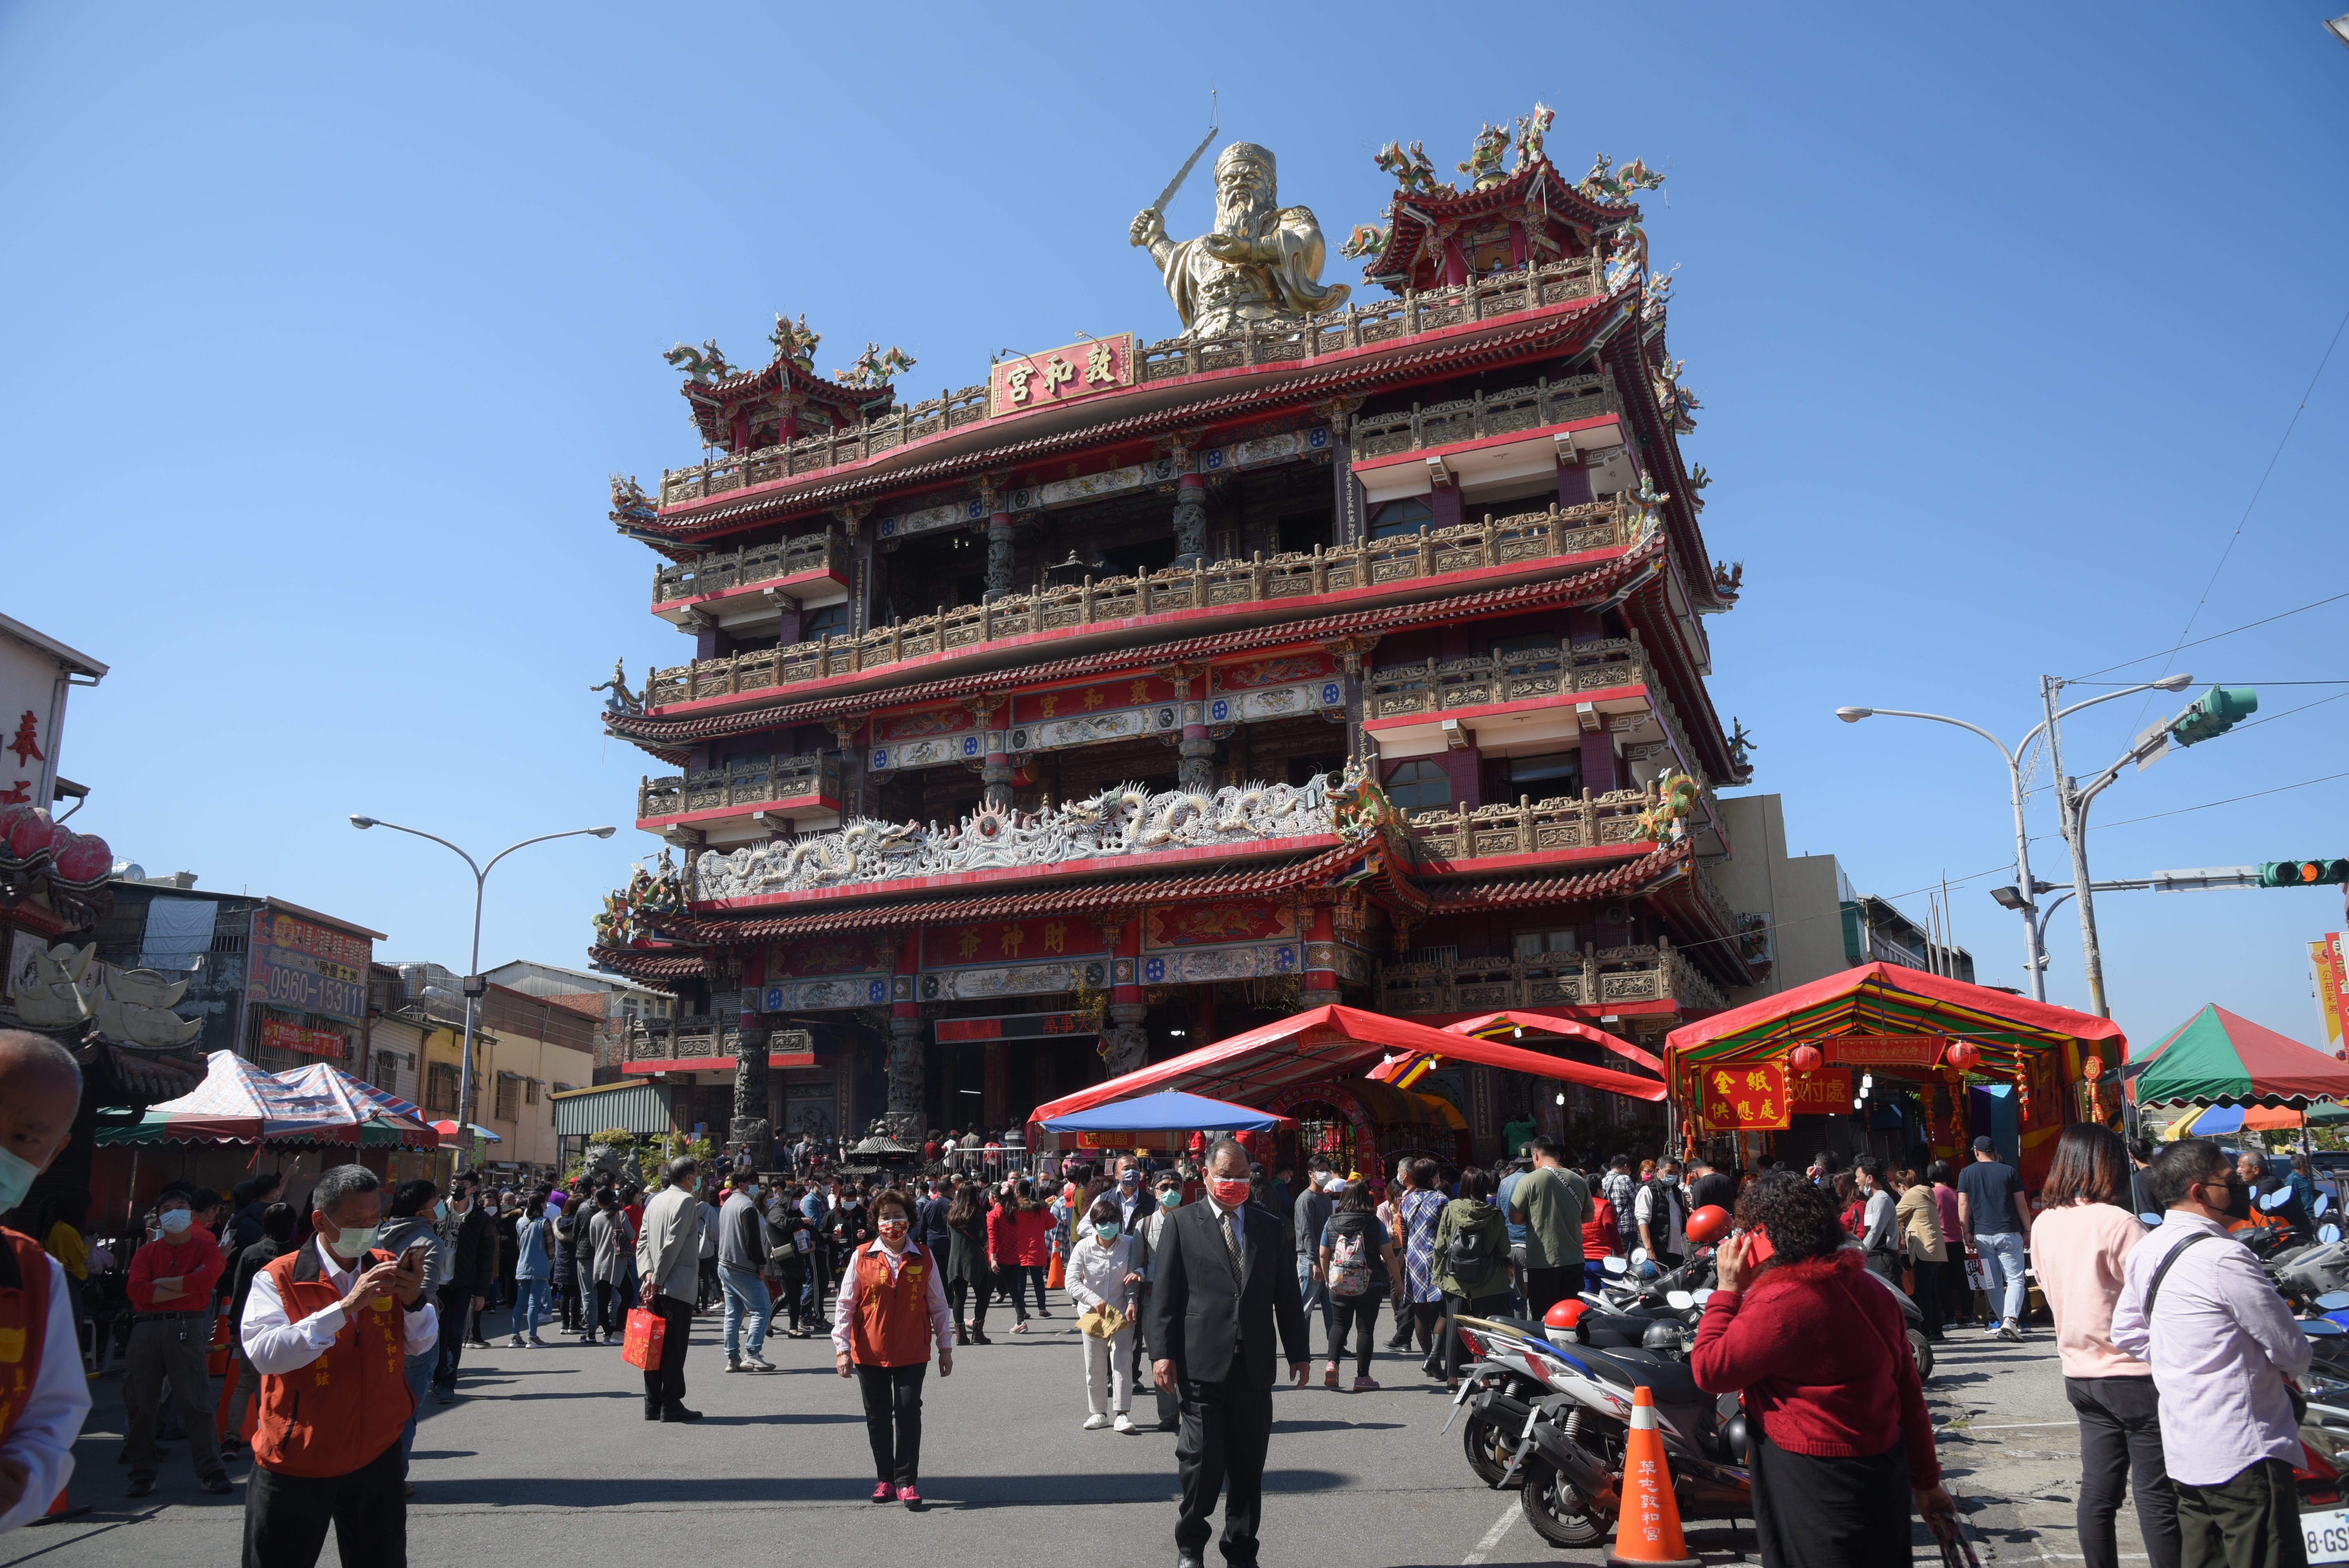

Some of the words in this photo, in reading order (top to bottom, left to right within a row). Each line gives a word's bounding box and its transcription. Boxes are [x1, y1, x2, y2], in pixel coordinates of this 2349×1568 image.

[1007, 343, 1116, 403] 敦和宮
[1040, 680, 1152, 718] 敦和宮
[957, 919, 1068, 961] 財神爺
[319, 960, 358, 983] 房屋土地
[271, 966, 365, 1017] 0960-153111
[2322, 970, 2339, 1015] 公益彩券
[273, 1024, 280, 1039] 賀
[2085, 1059, 2096, 1074] 福
[1713, 1071, 1772, 1095] 金紙
[1711, 1099, 1779, 1121] 供應處
[1085, 1132, 1128, 1145] 供應區
[1638, 1460, 1661, 1541] 草屯敦和宮
